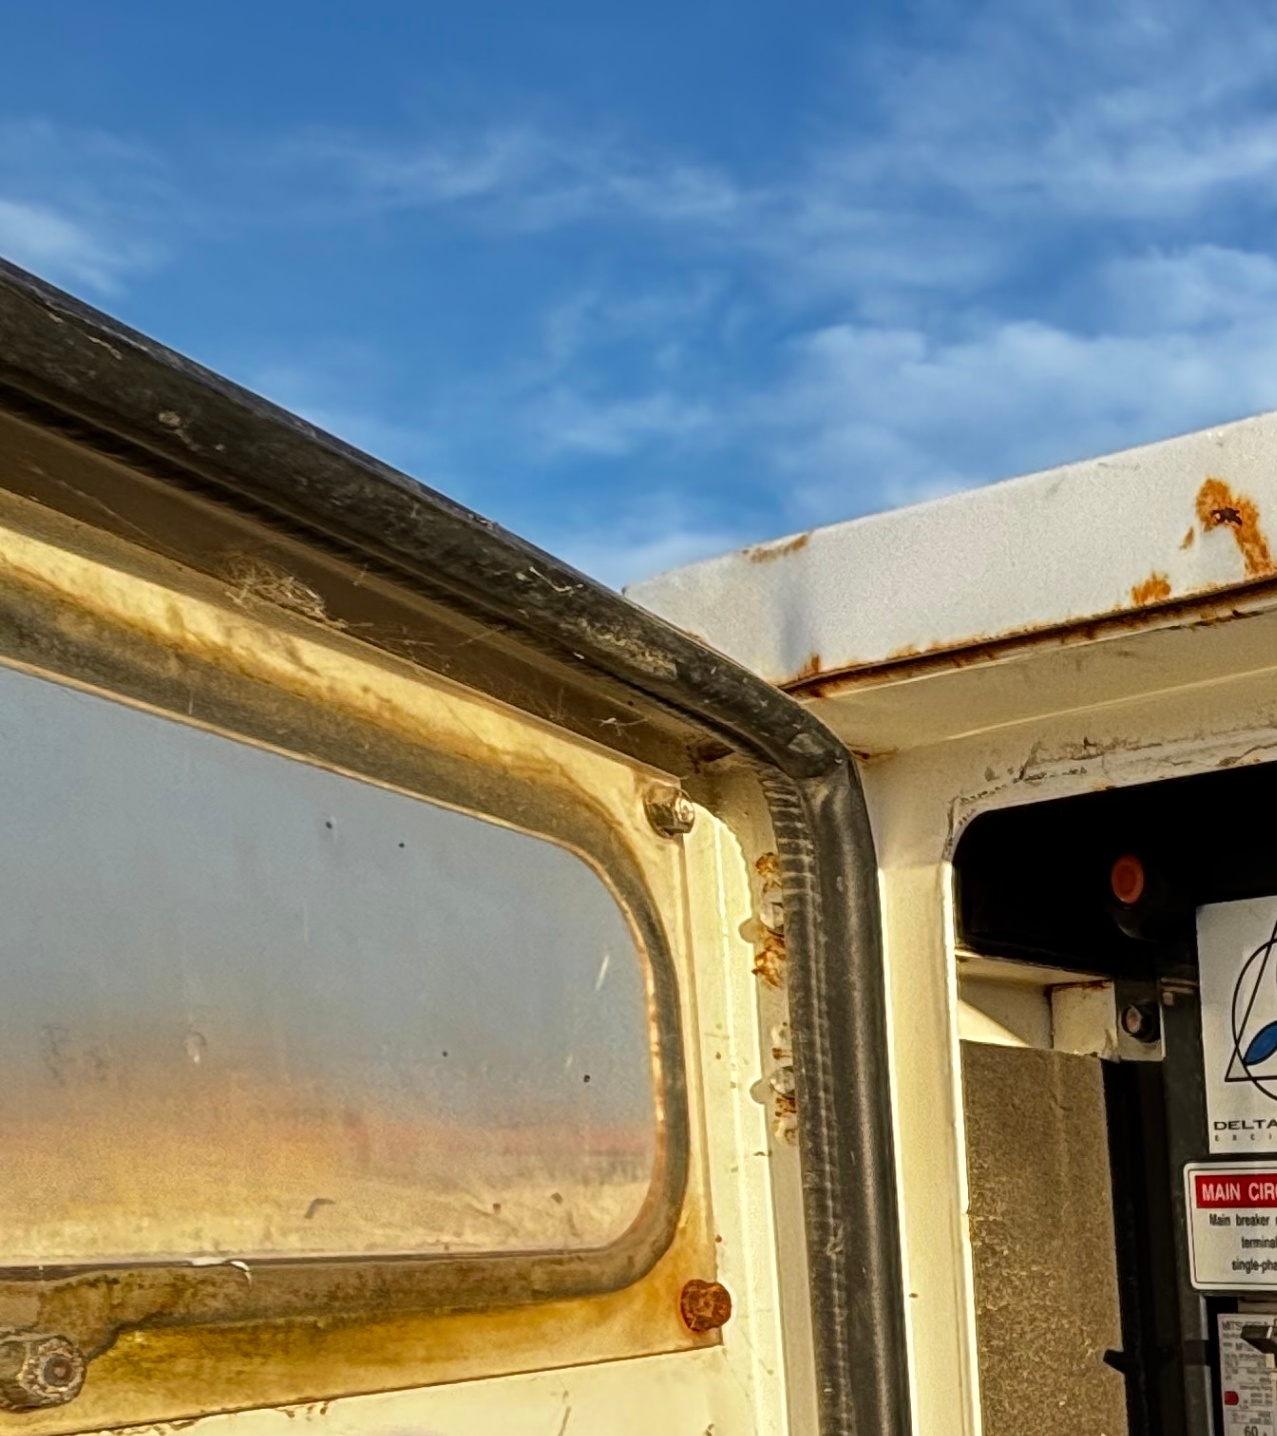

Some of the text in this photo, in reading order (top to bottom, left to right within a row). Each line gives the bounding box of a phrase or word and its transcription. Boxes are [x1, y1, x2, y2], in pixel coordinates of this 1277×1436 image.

[1202, 1183, 1240, 1201] MAIN
[1209, 1214, 1230, 1226] Main
[1236, 1214, 1270, 1226] breaker
[1242, 1237, 1277, 1248] terminal
